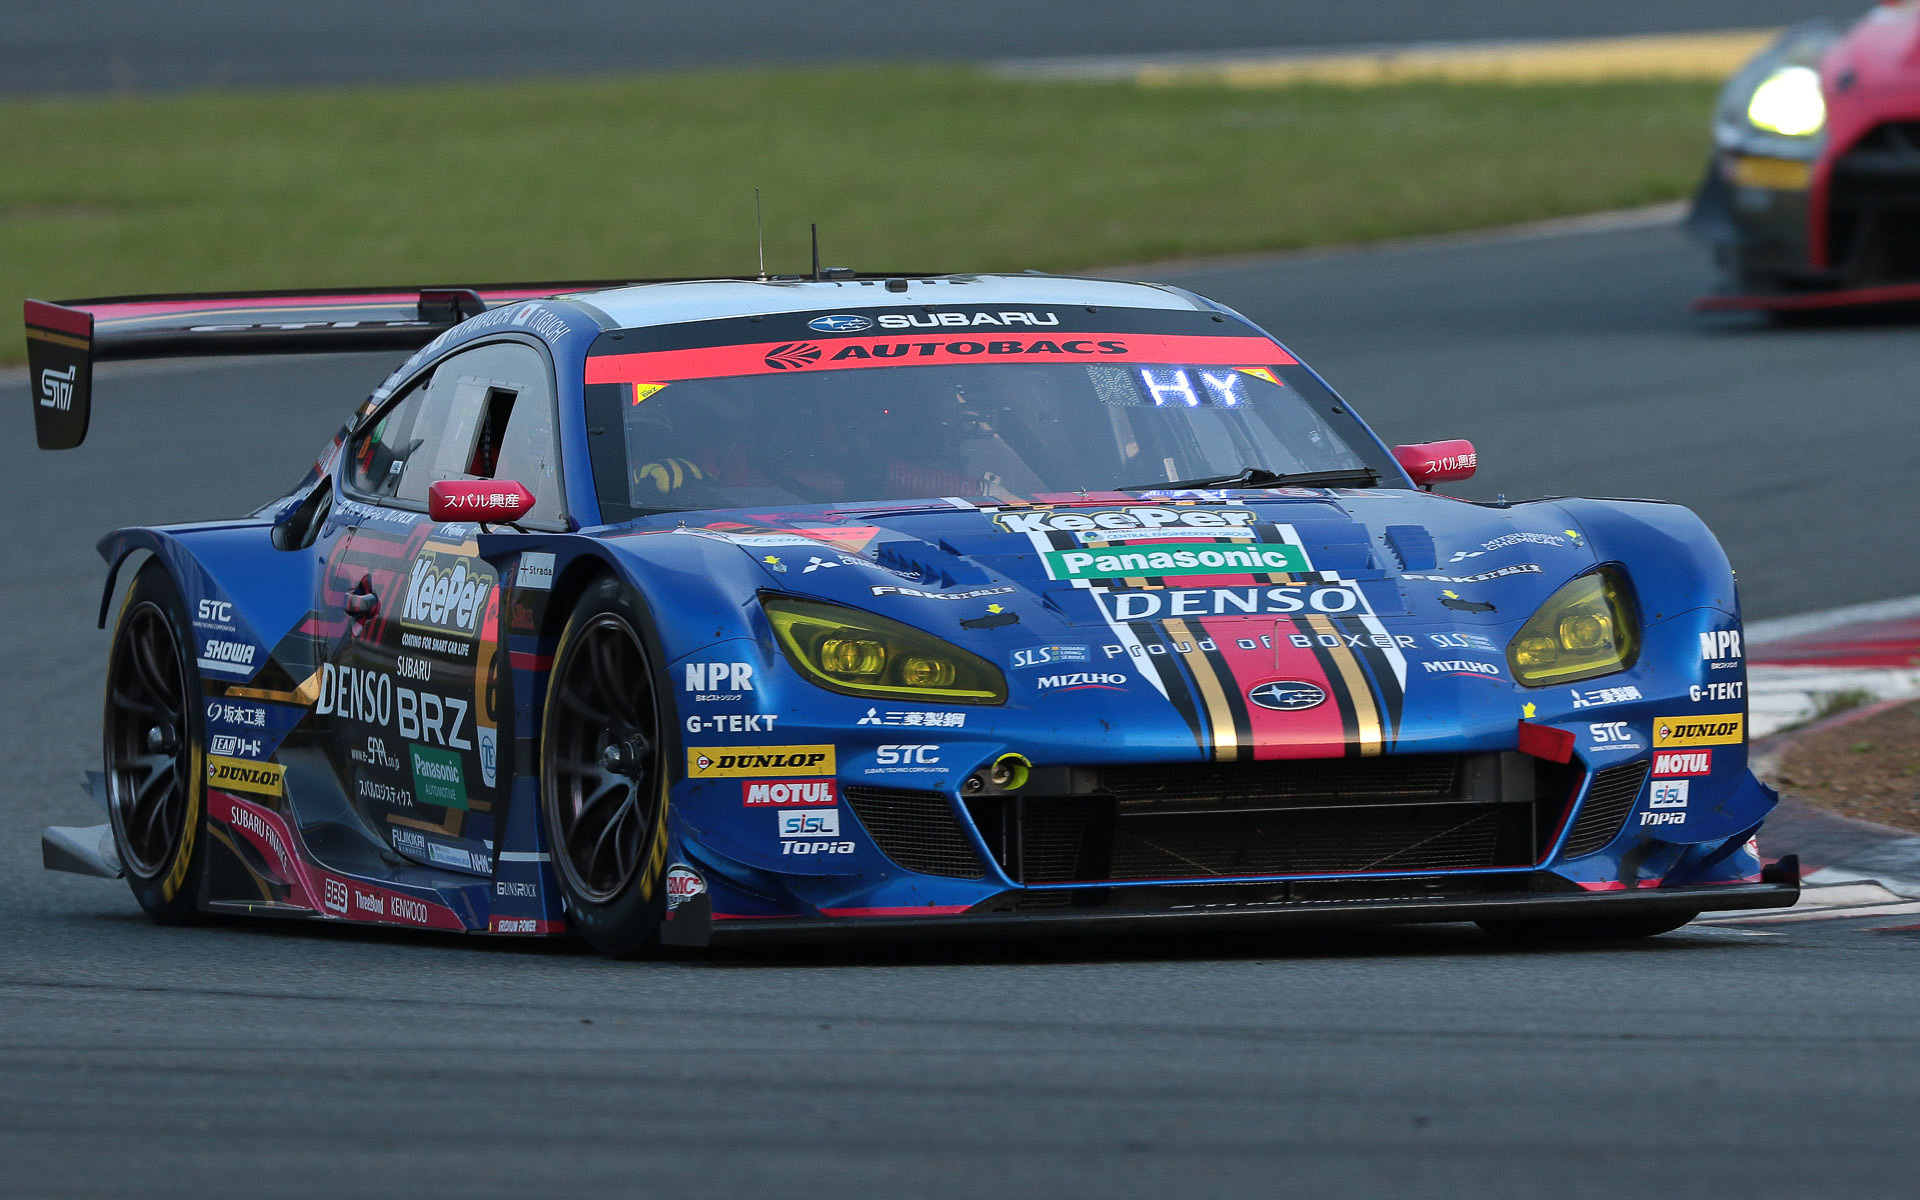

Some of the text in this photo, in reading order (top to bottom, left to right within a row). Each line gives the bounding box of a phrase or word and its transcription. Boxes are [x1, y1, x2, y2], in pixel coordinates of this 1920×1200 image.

[878, 310, 1059, 329] SUBARU
[830, 338, 1129, 361] AUTOBACS
[1425, 453, 1477, 474] スバル興産
[444, 493, 520, 508] スバル興産
[1000, 507, 1251, 532] KeePer
[1107, 532, 1151, 540] CENTRAL
[1060, 546, 1289, 574] Panasonic
[403, 558, 489, 630] KeePer
[1113, 588, 1358, 620] DENSO
[198, 599, 232, 622] STC
[1101, 636, 1218, 660] Proud
[1288, 633, 1419, 650] BOXER
[1430, 633, 1469, 648] SLS
[1699, 630, 1742, 660] NPR
[204, 640, 256, 664] SHOWA
[1014, 647, 1052, 667] SLS
[396, 656, 432, 682] SUBARU
[684, 662, 754, 692] NPR
[1421, 660, 1500, 675] MIZUHO
[1037, 673, 1127, 689] MIZUHO
[1689, 681, 1743, 702] G-TEKT
[316, 662, 391, 727] DENSO
[223, 704, 266, 727] 坂本工業
[396, 687, 472, 750] BRZ
[686, 714, 778, 733] G-TEKT
[884, 712, 966, 728] 三菱製鋼
[1589, 721, 1631, 742] STC
[1672, 722, 1738, 738] DUNLOP
[237, 738, 261, 757] リード
[876, 744, 941, 765] STC
[414, 752, 460, 784] Panasonic
[716, 752, 826, 769] DUNLOP
[1654, 752, 1709, 774] MOTUL
[218, 765, 280, 786] DUNLOP
[746, 782, 833, 804] MOTUL
[230, 806, 288, 874] SUBARU FINANCE
[325, 878, 349, 913] BBS
[355, 890, 384, 914] ThreeBond
[390, 896, 428, 924] KENWOOD
